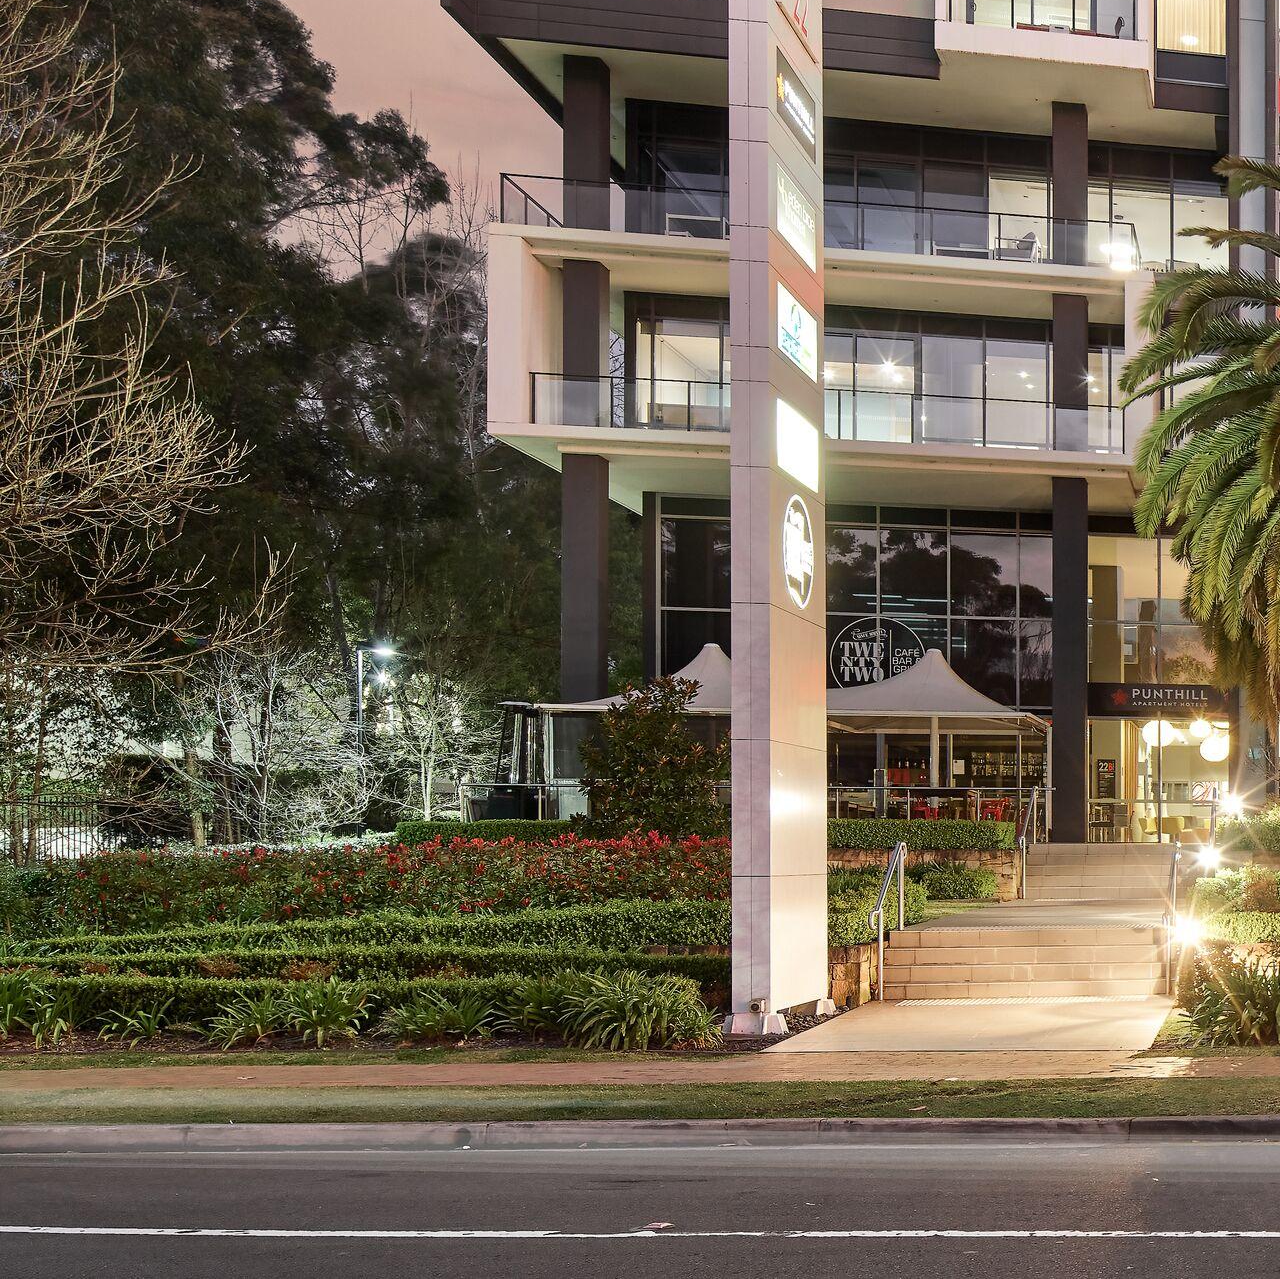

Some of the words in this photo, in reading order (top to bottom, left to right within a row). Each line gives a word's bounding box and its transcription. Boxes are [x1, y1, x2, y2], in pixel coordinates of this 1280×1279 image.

[840, 642, 885, 657] TWE
[894, 647, 920, 657] CAFÉ
[840, 657, 883, 667] NTY
[892, 657, 912, 665] BAR
[840, 667, 885, 682] TWO
[1132, 688, 1208, 700] PUNTHILL
